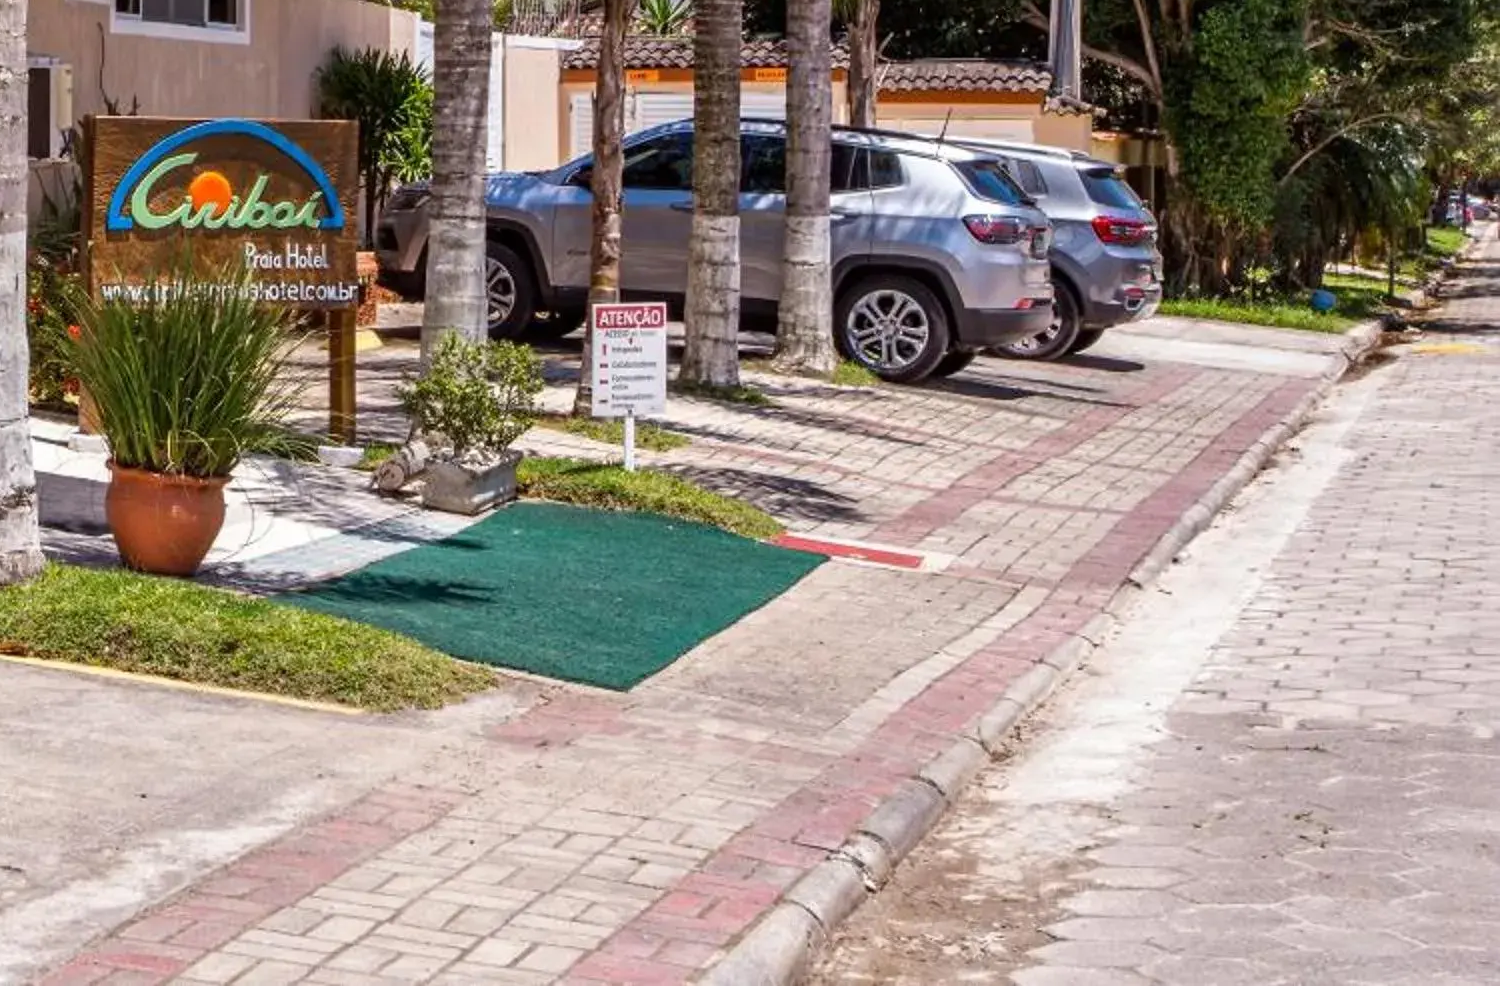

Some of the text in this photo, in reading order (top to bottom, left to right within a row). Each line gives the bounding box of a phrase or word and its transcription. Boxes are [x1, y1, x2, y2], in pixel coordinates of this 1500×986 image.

[244, 241, 329, 269] Praia Hotel
[600, 307, 661, 329] ATENÇÃO
